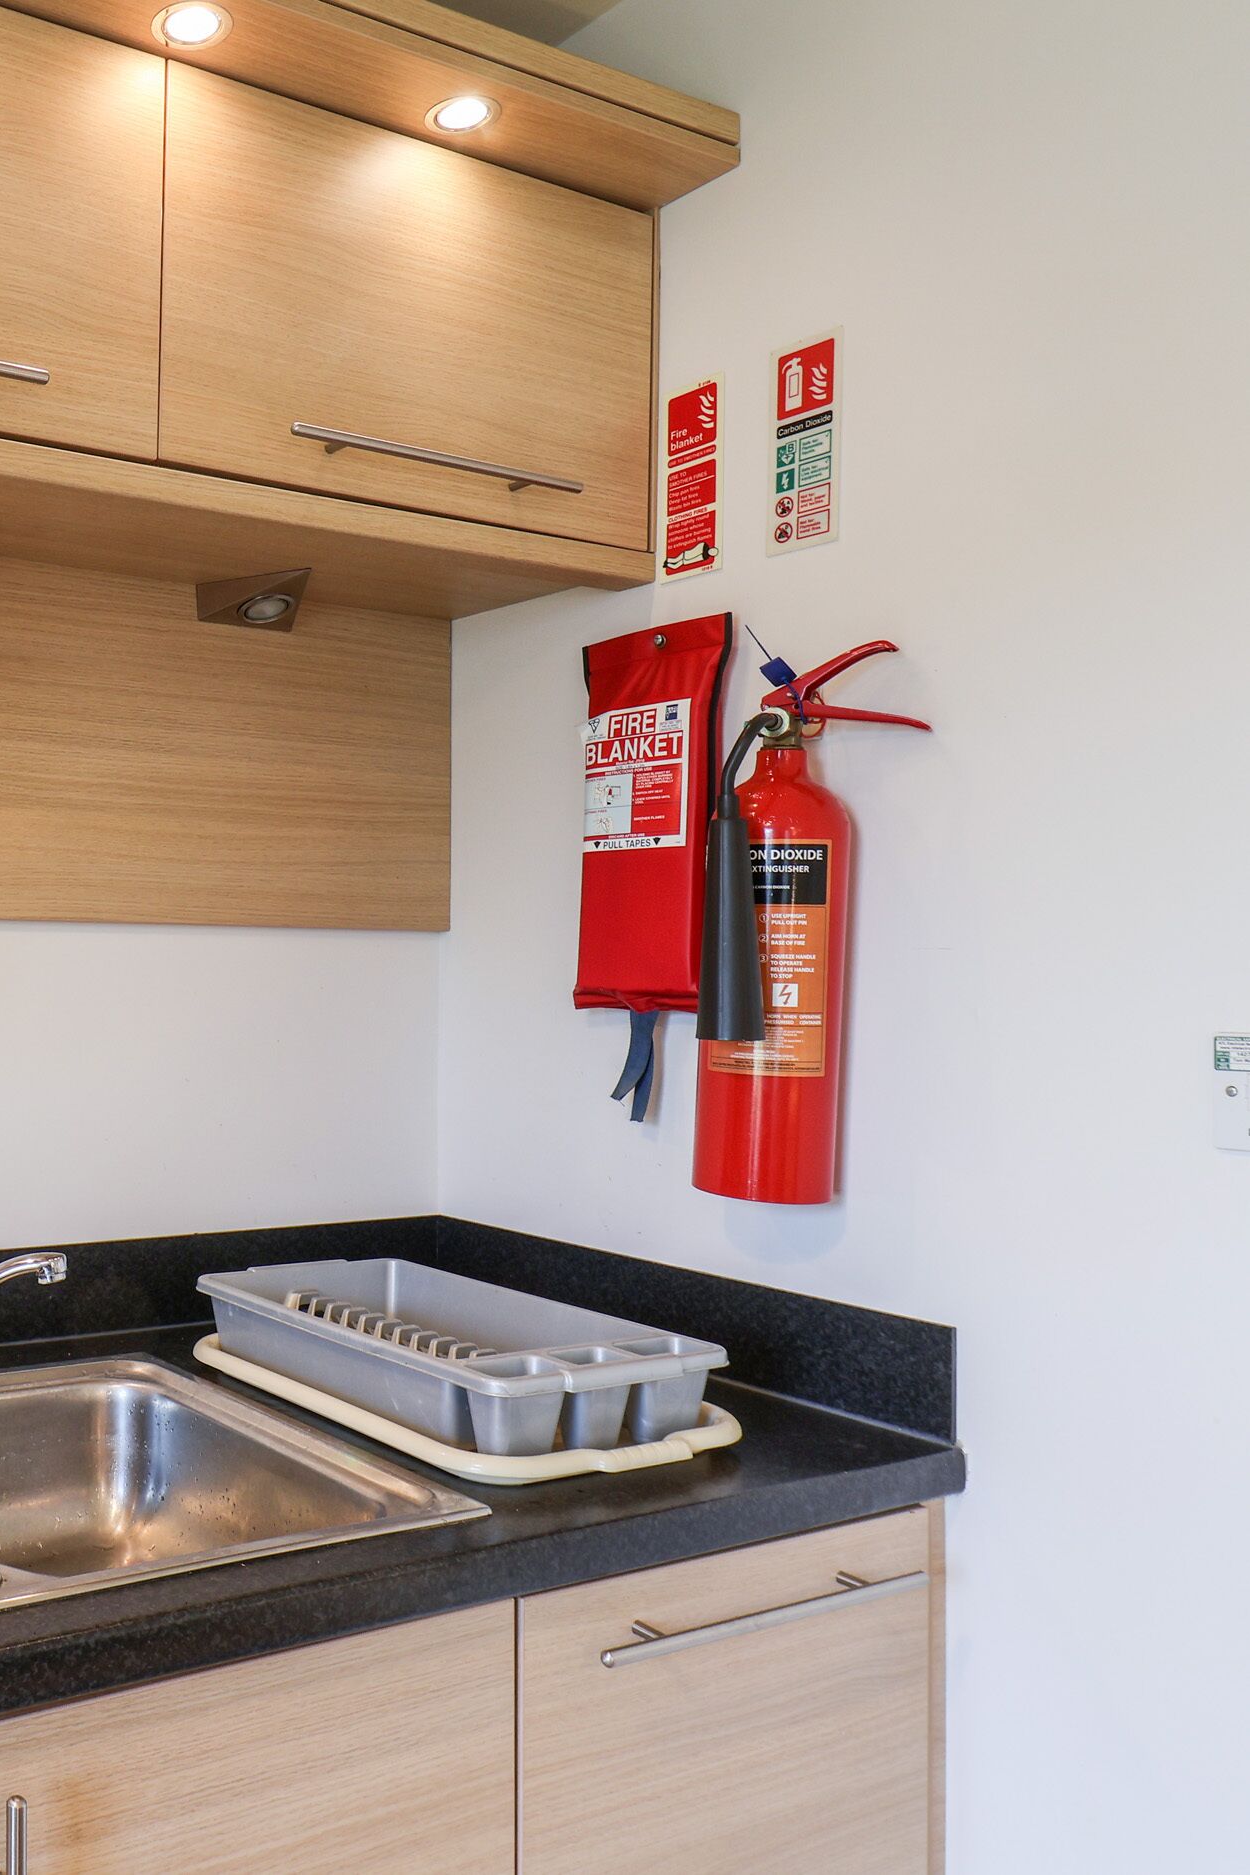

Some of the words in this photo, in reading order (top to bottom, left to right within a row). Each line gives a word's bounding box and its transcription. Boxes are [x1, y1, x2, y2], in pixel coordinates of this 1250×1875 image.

[778, 423, 804, 437] Carbon
[805, 414, 832, 428] Dioxide
[670, 429, 688, 440] Fire
[670, 432, 703, 452] blanket
[610, 710, 656, 738] FIRE
[586, 732, 683, 766] BLANKET
[603, 840, 623, 849] PULL
[626, 838, 650, 848] TAPES
[750, 849, 767, 860] ON
[770, 849, 824, 860] DIOXIDE
[752, 864, 810, 873] XTINGUISHER
